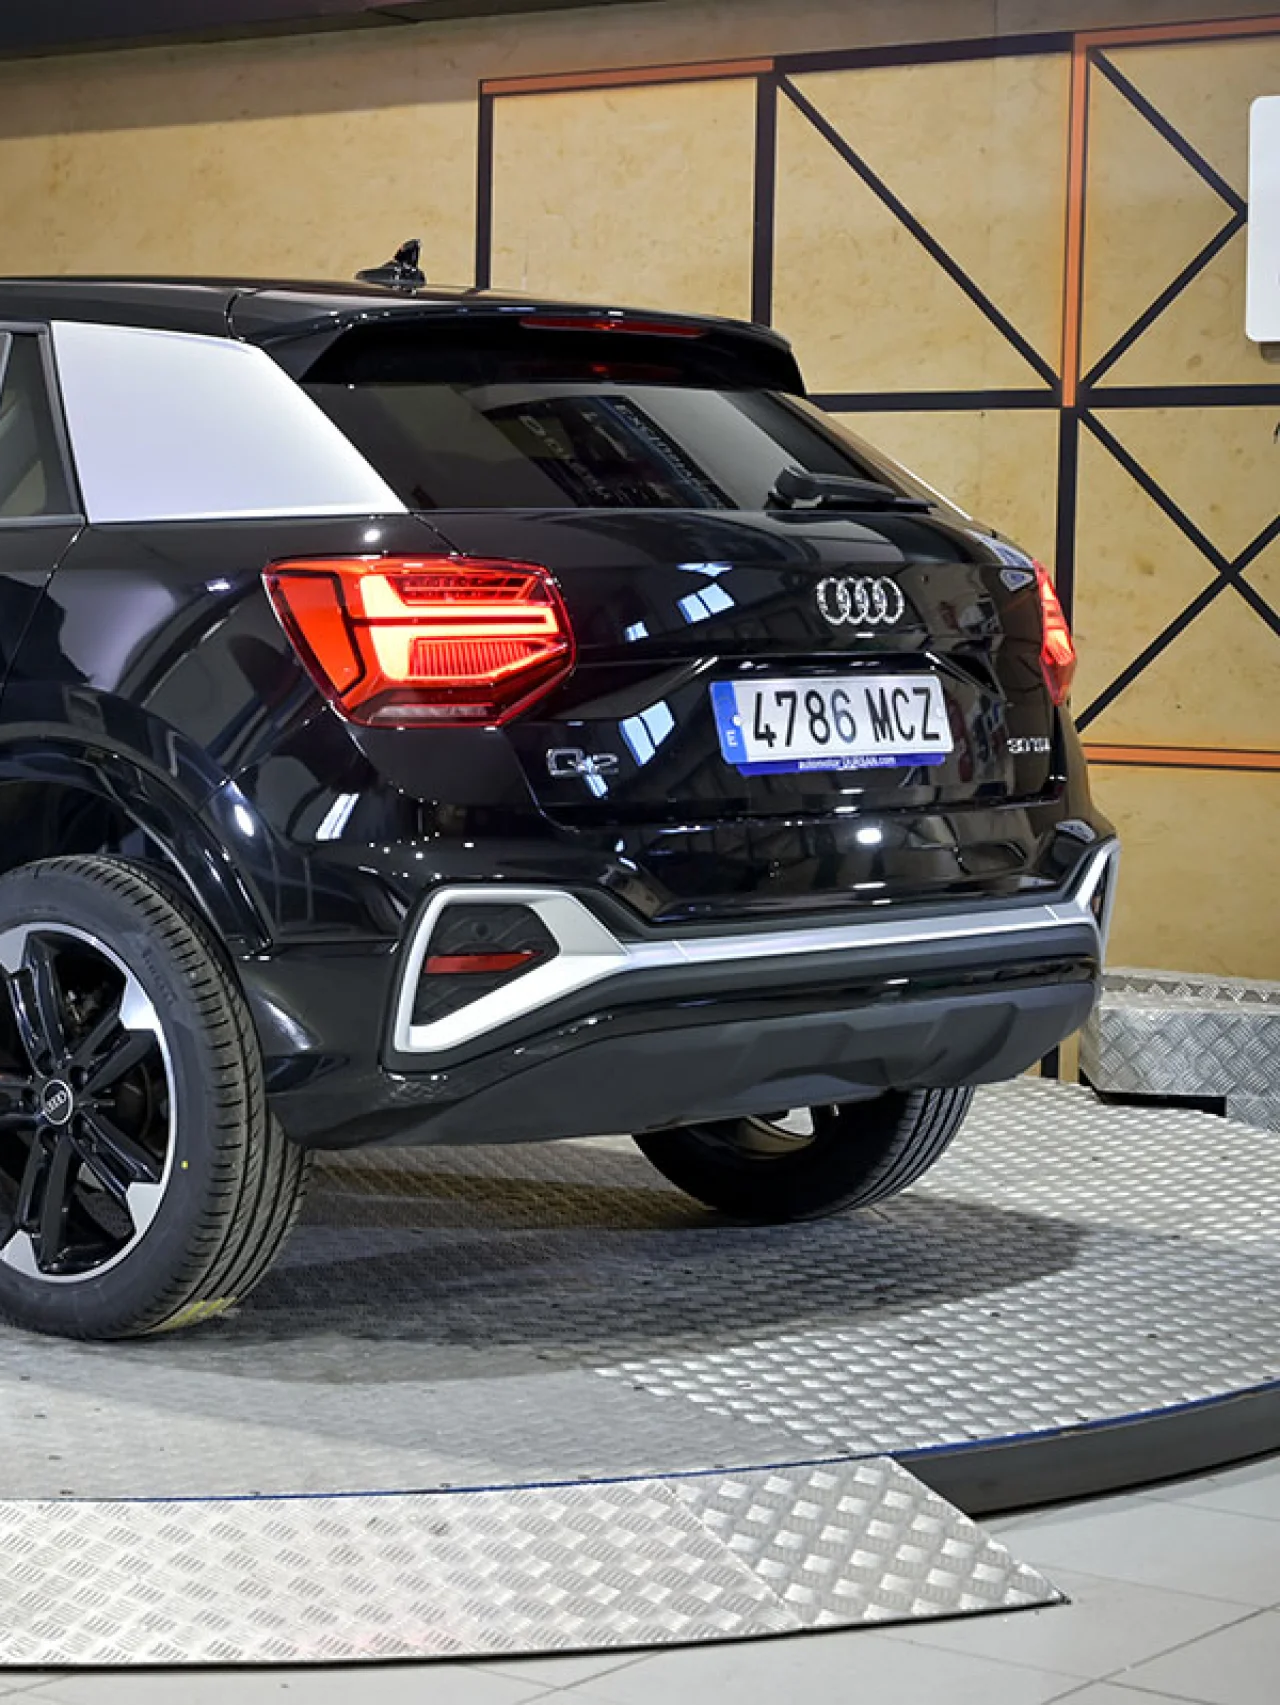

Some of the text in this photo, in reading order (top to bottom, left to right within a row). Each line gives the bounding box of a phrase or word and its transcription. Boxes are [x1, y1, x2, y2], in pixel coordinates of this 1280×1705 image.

[753, 687, 940, 747] 4786 MCZ
[726, 730, 738, 747] E
[546, 749, 619, 778] Q2
